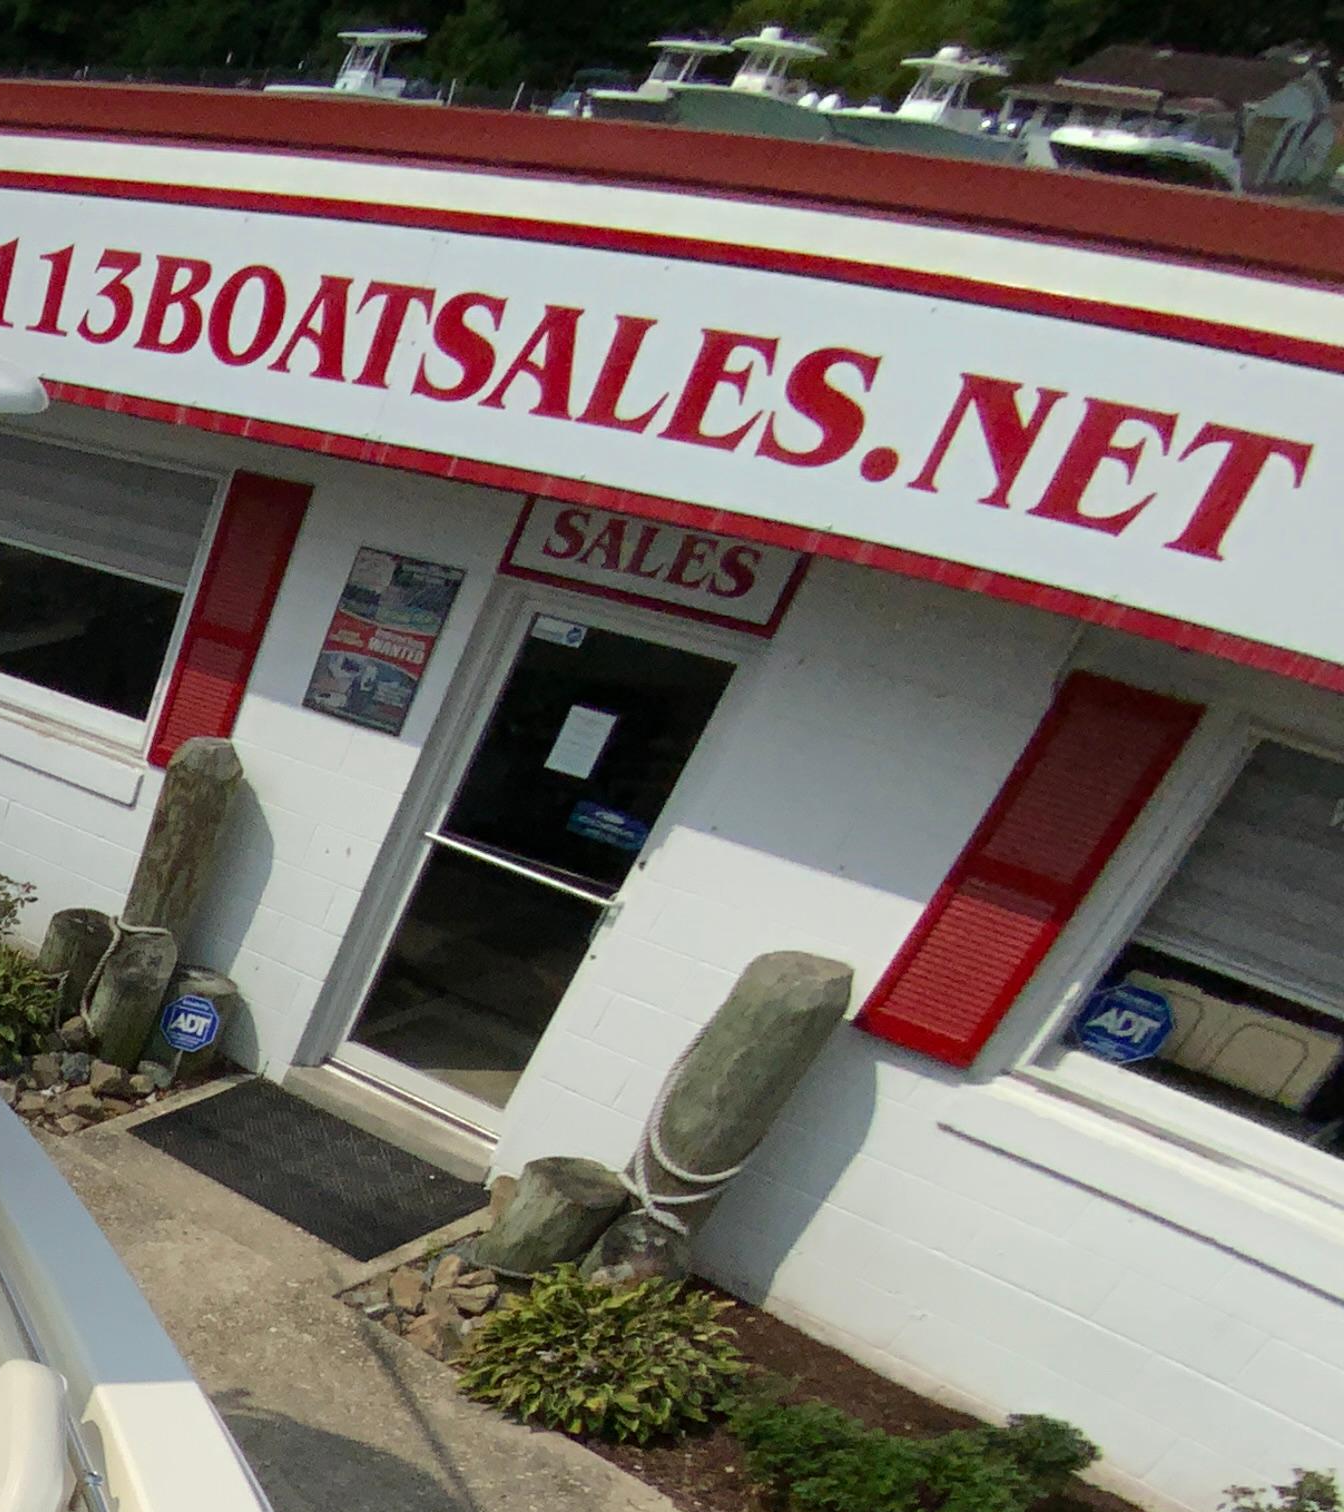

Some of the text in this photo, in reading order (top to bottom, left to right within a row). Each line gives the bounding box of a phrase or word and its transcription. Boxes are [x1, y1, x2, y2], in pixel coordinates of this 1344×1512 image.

[542, 509, 762, 599] SALES
[368, 637, 425, 665] WANTED
[171, 1012, 212, 1035] ADT
[1086, 1008, 1161, 1042] ADT
